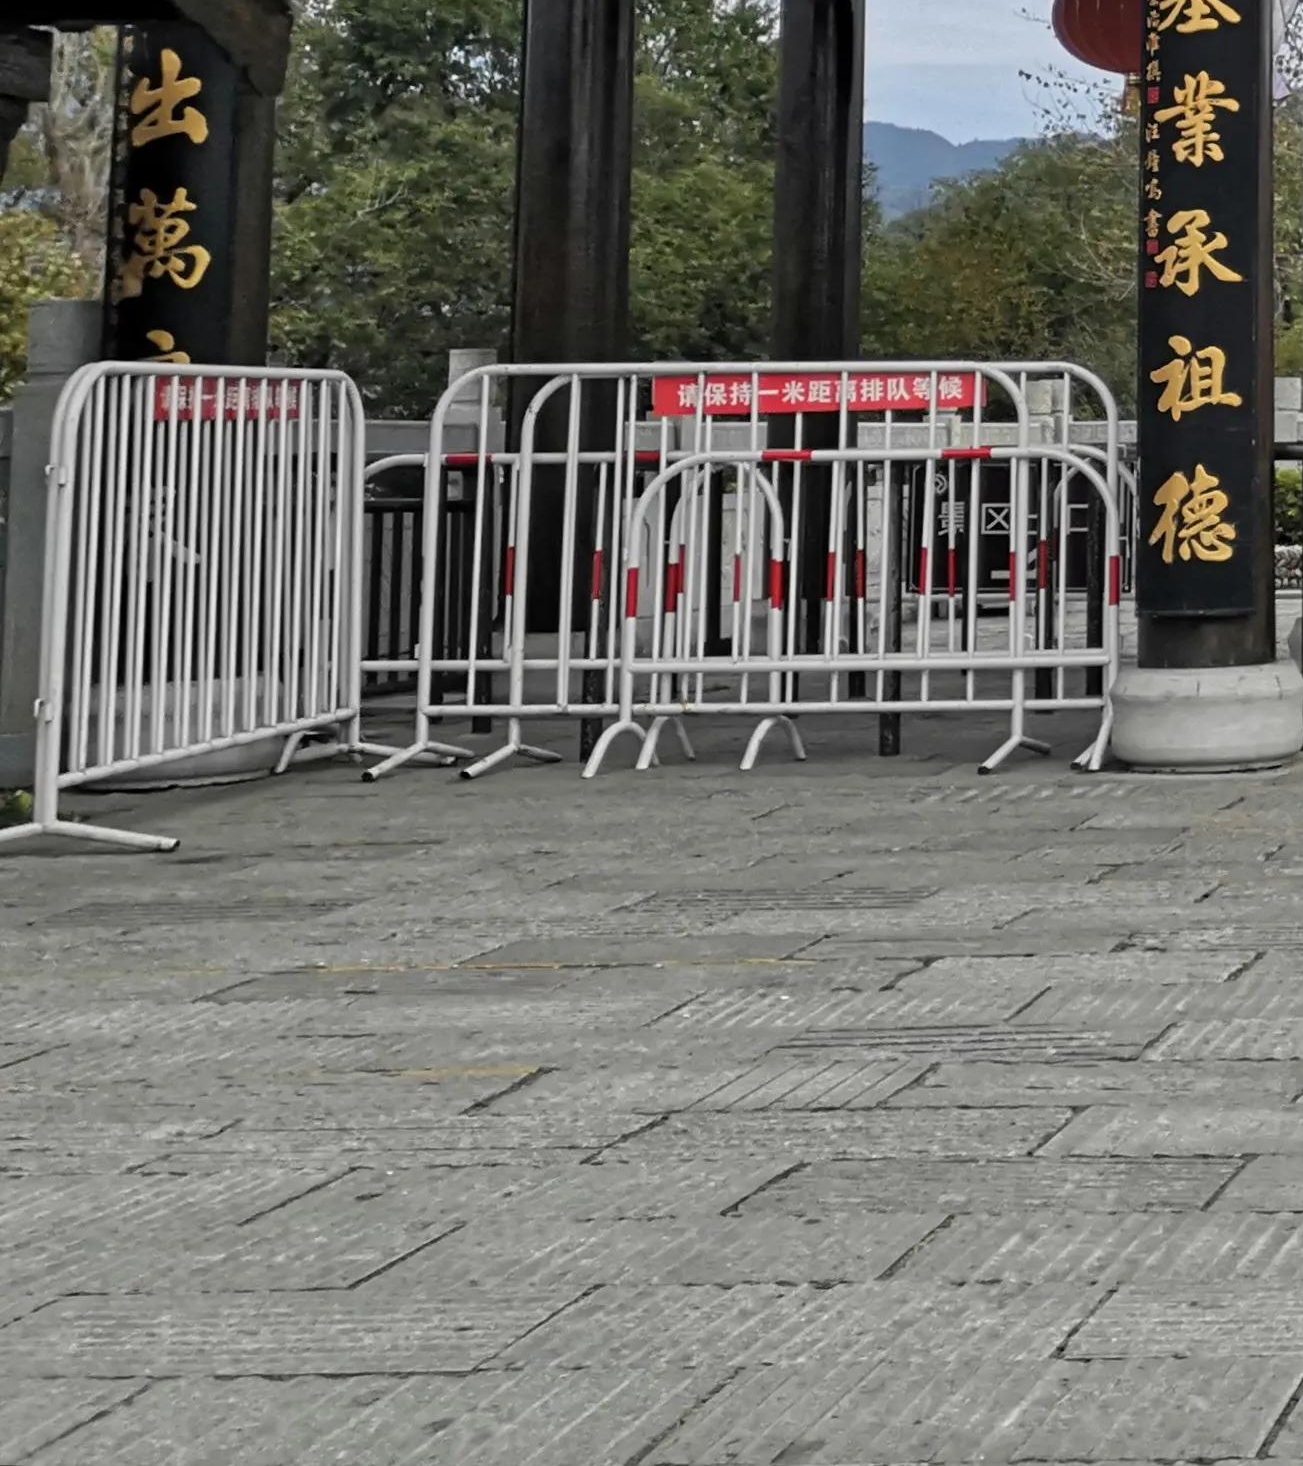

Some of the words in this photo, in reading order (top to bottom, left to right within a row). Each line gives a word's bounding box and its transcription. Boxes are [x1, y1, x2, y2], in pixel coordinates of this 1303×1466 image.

[678, 377, 964, 407] 请保持一米距离排队等候
